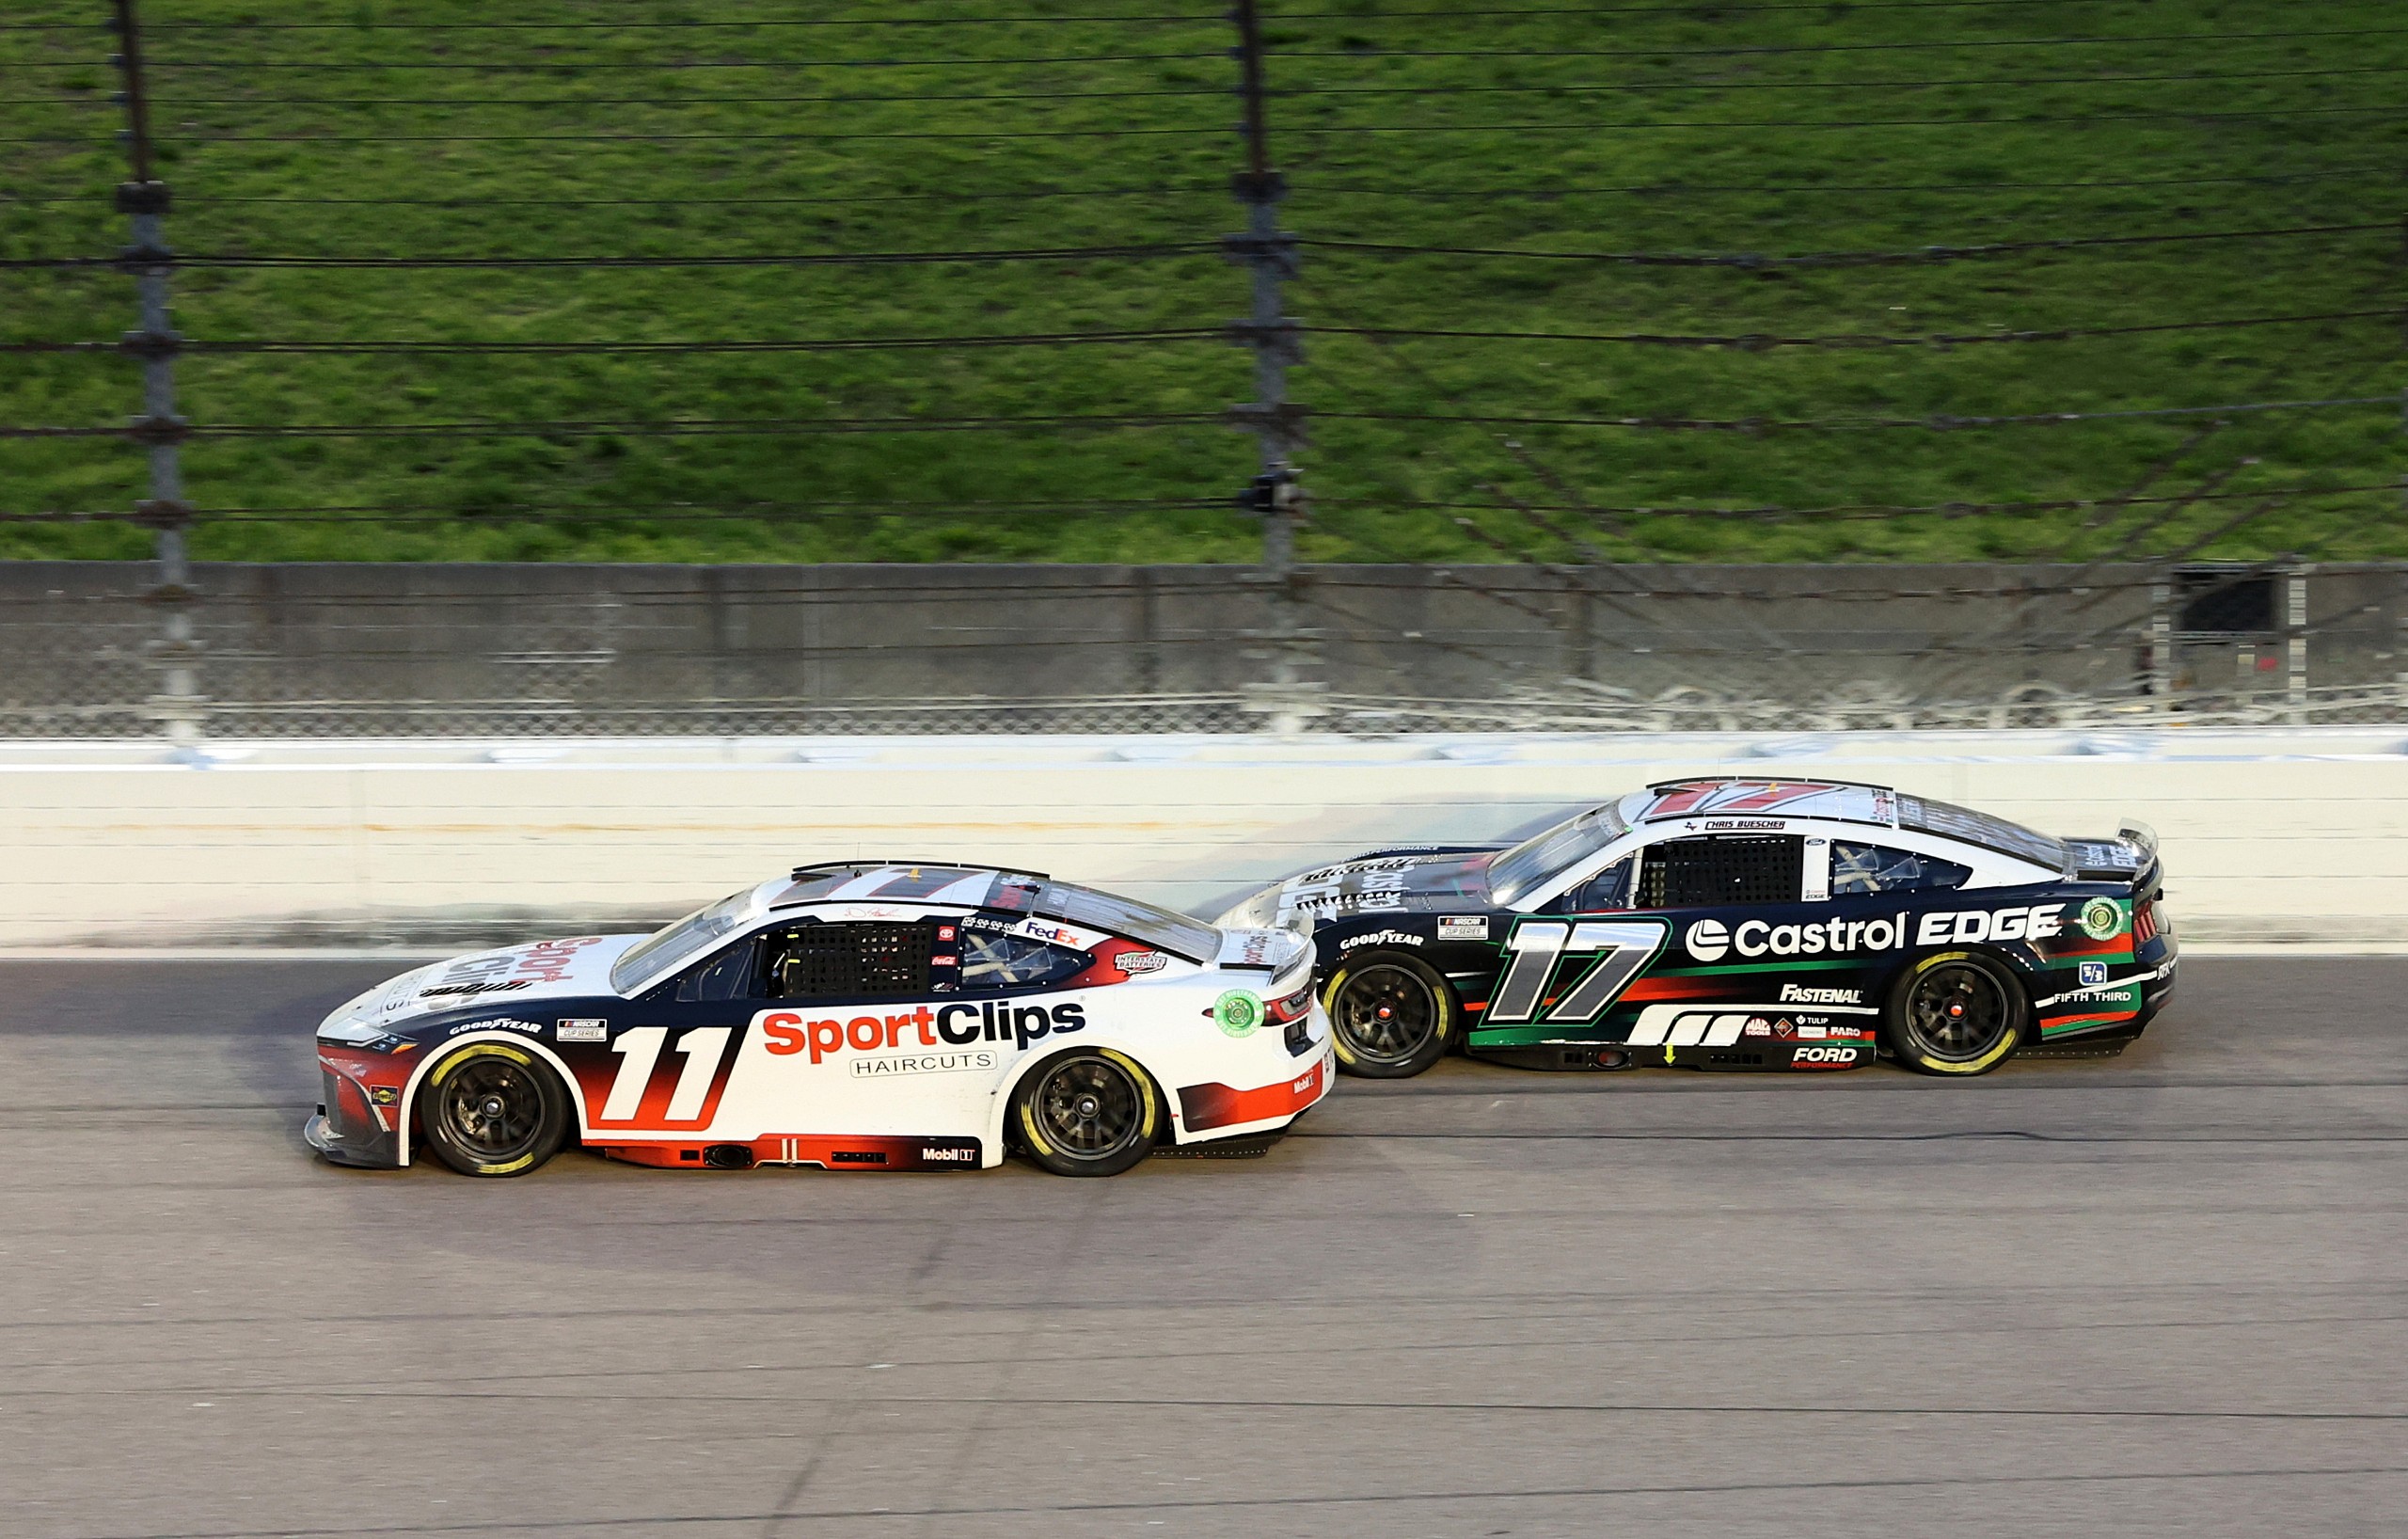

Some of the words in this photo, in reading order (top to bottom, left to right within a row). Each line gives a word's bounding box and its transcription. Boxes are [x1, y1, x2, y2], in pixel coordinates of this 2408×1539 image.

[1704, 820, 1735, 830] CHRIS
[1737, 820, 1786, 829] BUESCHER
[1025, 922, 1083, 946] FedEx
[1339, 929, 1424, 950] GOODYEAR
[1735, 912, 1906, 956] Castrol
[1915, 903, 2067, 945] EDGE
[1487, 922, 1666, 1023] 17
[2053, 992, 2089, 1003] FIFTH
[2093, 992, 2131, 1002] THIRD
[449, 1018, 542, 1035] GOODYEAR
[763, 1001, 1086, 1064] SportClips
[1830, 1026, 1861, 1037] FARO
[855, 1054, 991, 1075] HAIRCUTS
[1793, 1048, 1858, 1062] FORD
[599, 1026, 733, 1120] 11
[923, 1148, 958, 1161] Mobil
